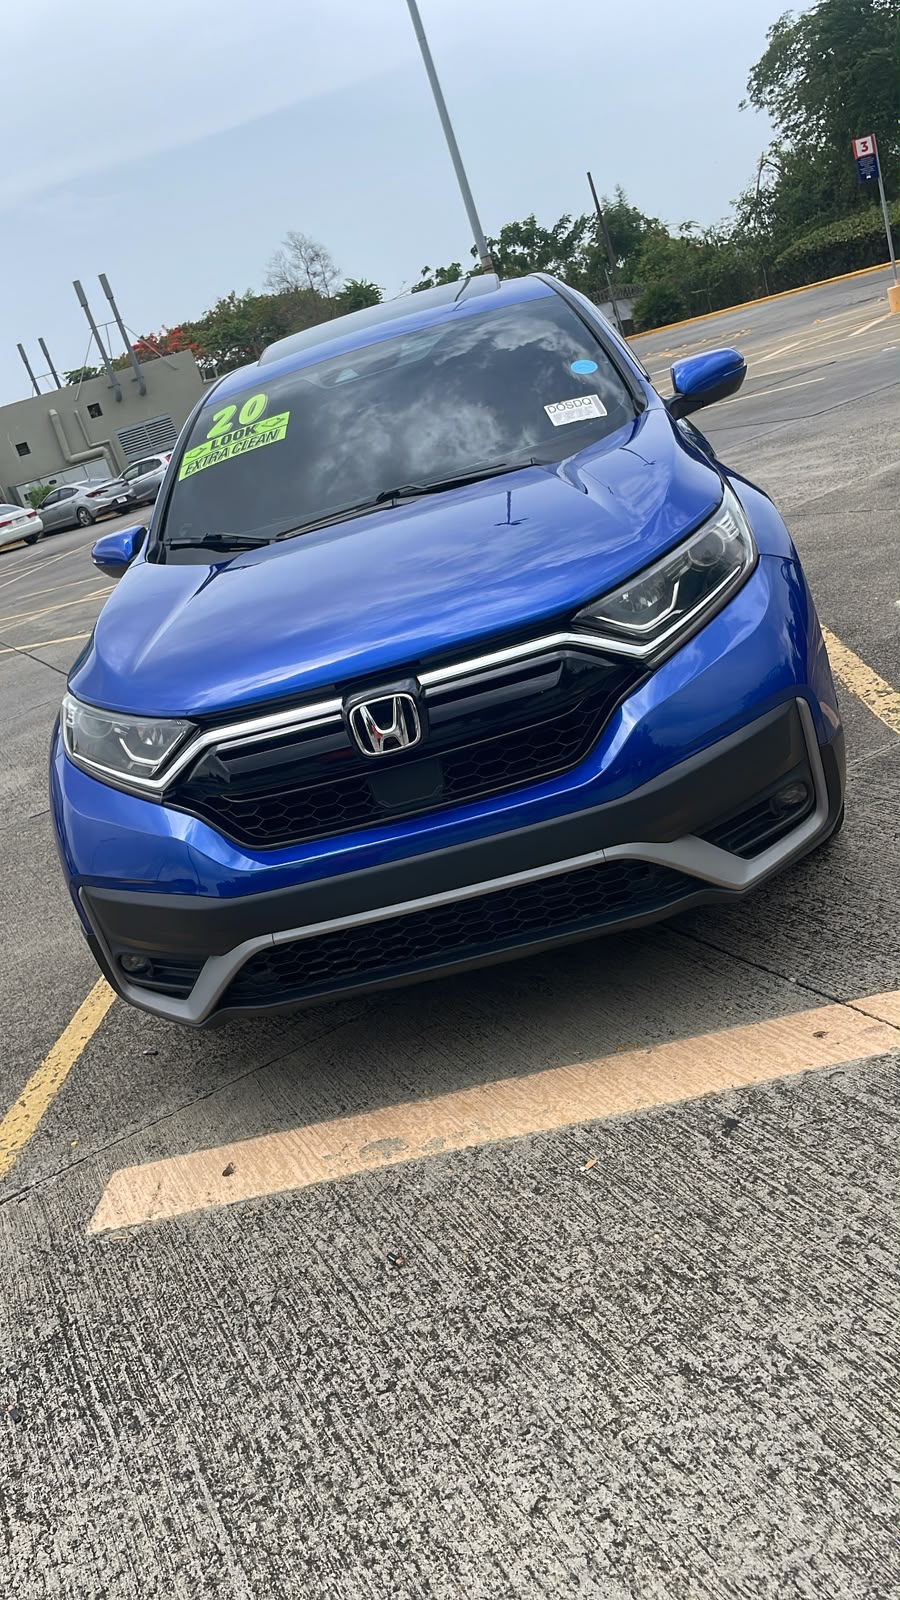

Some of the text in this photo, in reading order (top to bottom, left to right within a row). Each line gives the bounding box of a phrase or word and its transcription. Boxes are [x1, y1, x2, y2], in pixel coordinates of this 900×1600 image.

[860, 141, 869, 152] 3
[207, 394, 268, 439] 20
[185, 429, 279, 476] EXTRA CLEAN
[210, 424, 257, 450] LOOK
